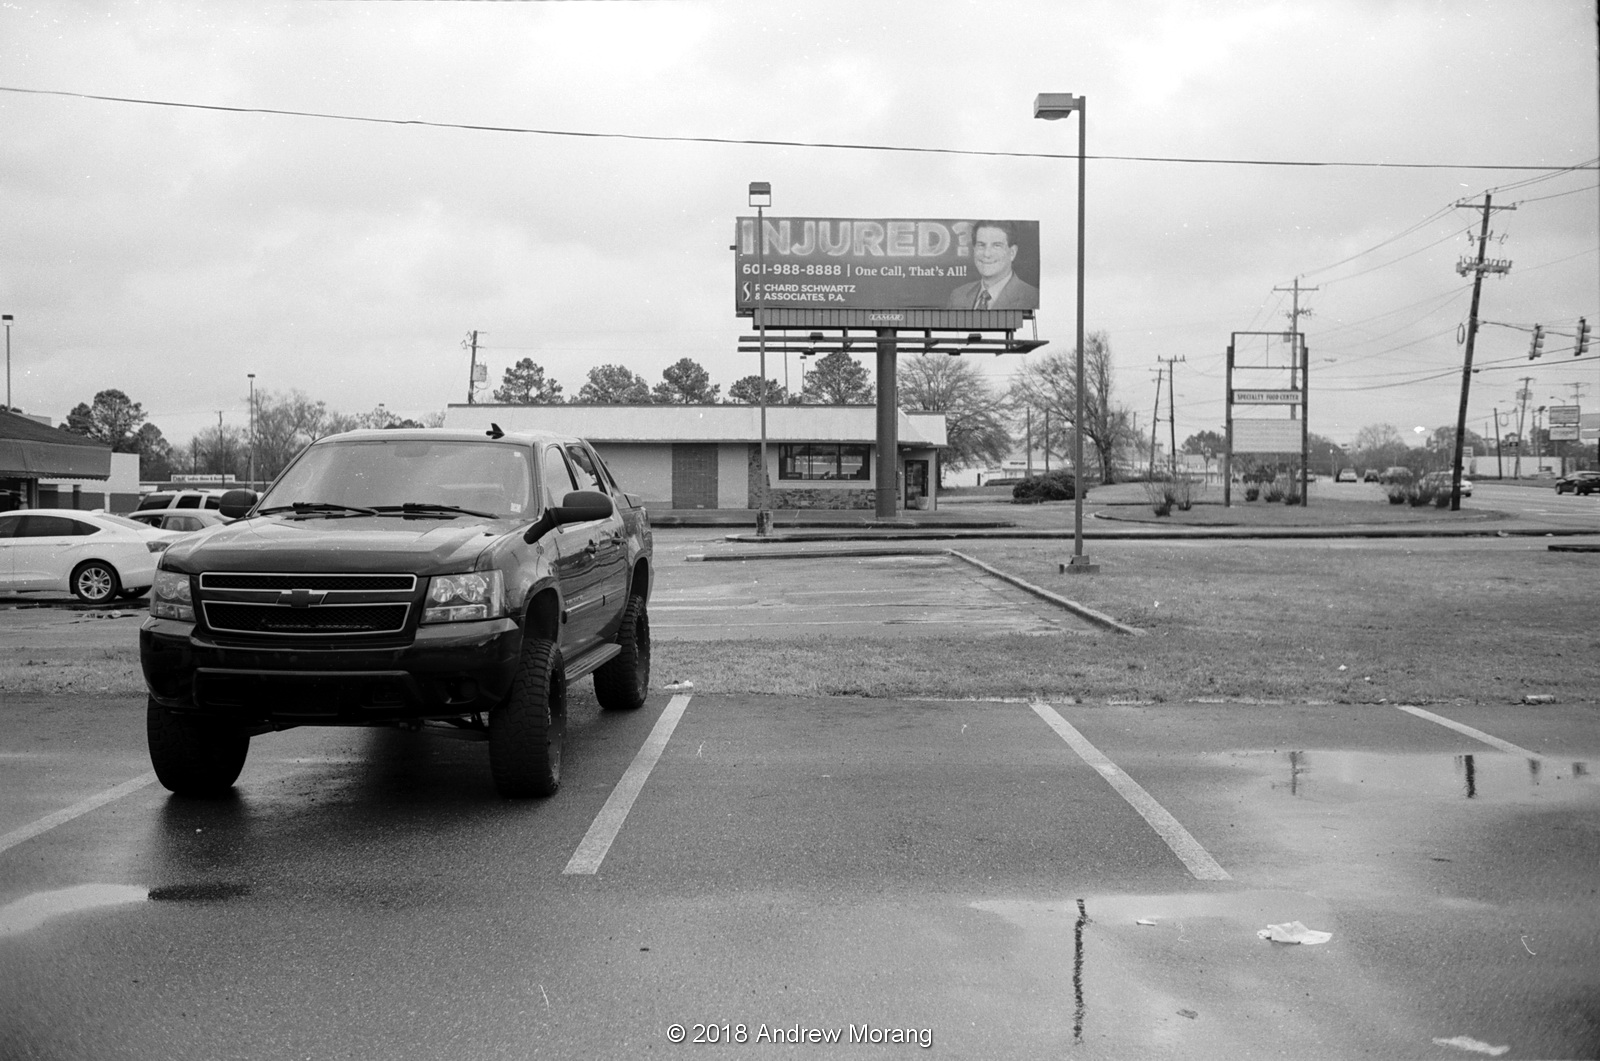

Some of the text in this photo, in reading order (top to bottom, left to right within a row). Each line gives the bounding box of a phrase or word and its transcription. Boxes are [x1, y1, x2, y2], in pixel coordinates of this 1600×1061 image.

[742, 219, 974, 256] INJURED?
[742, 263, 842, 275] 601-988-8888
[855, 265, 878, 276] One
[880, 265, 906, 278] Call,
[946, 265, 968, 277] All!
[755, 283, 857, 293] RCHARD SCHWARTZ
[764, 292, 826, 301] ASSOCIATES,
[828, 293, 846, 302] P.A.
